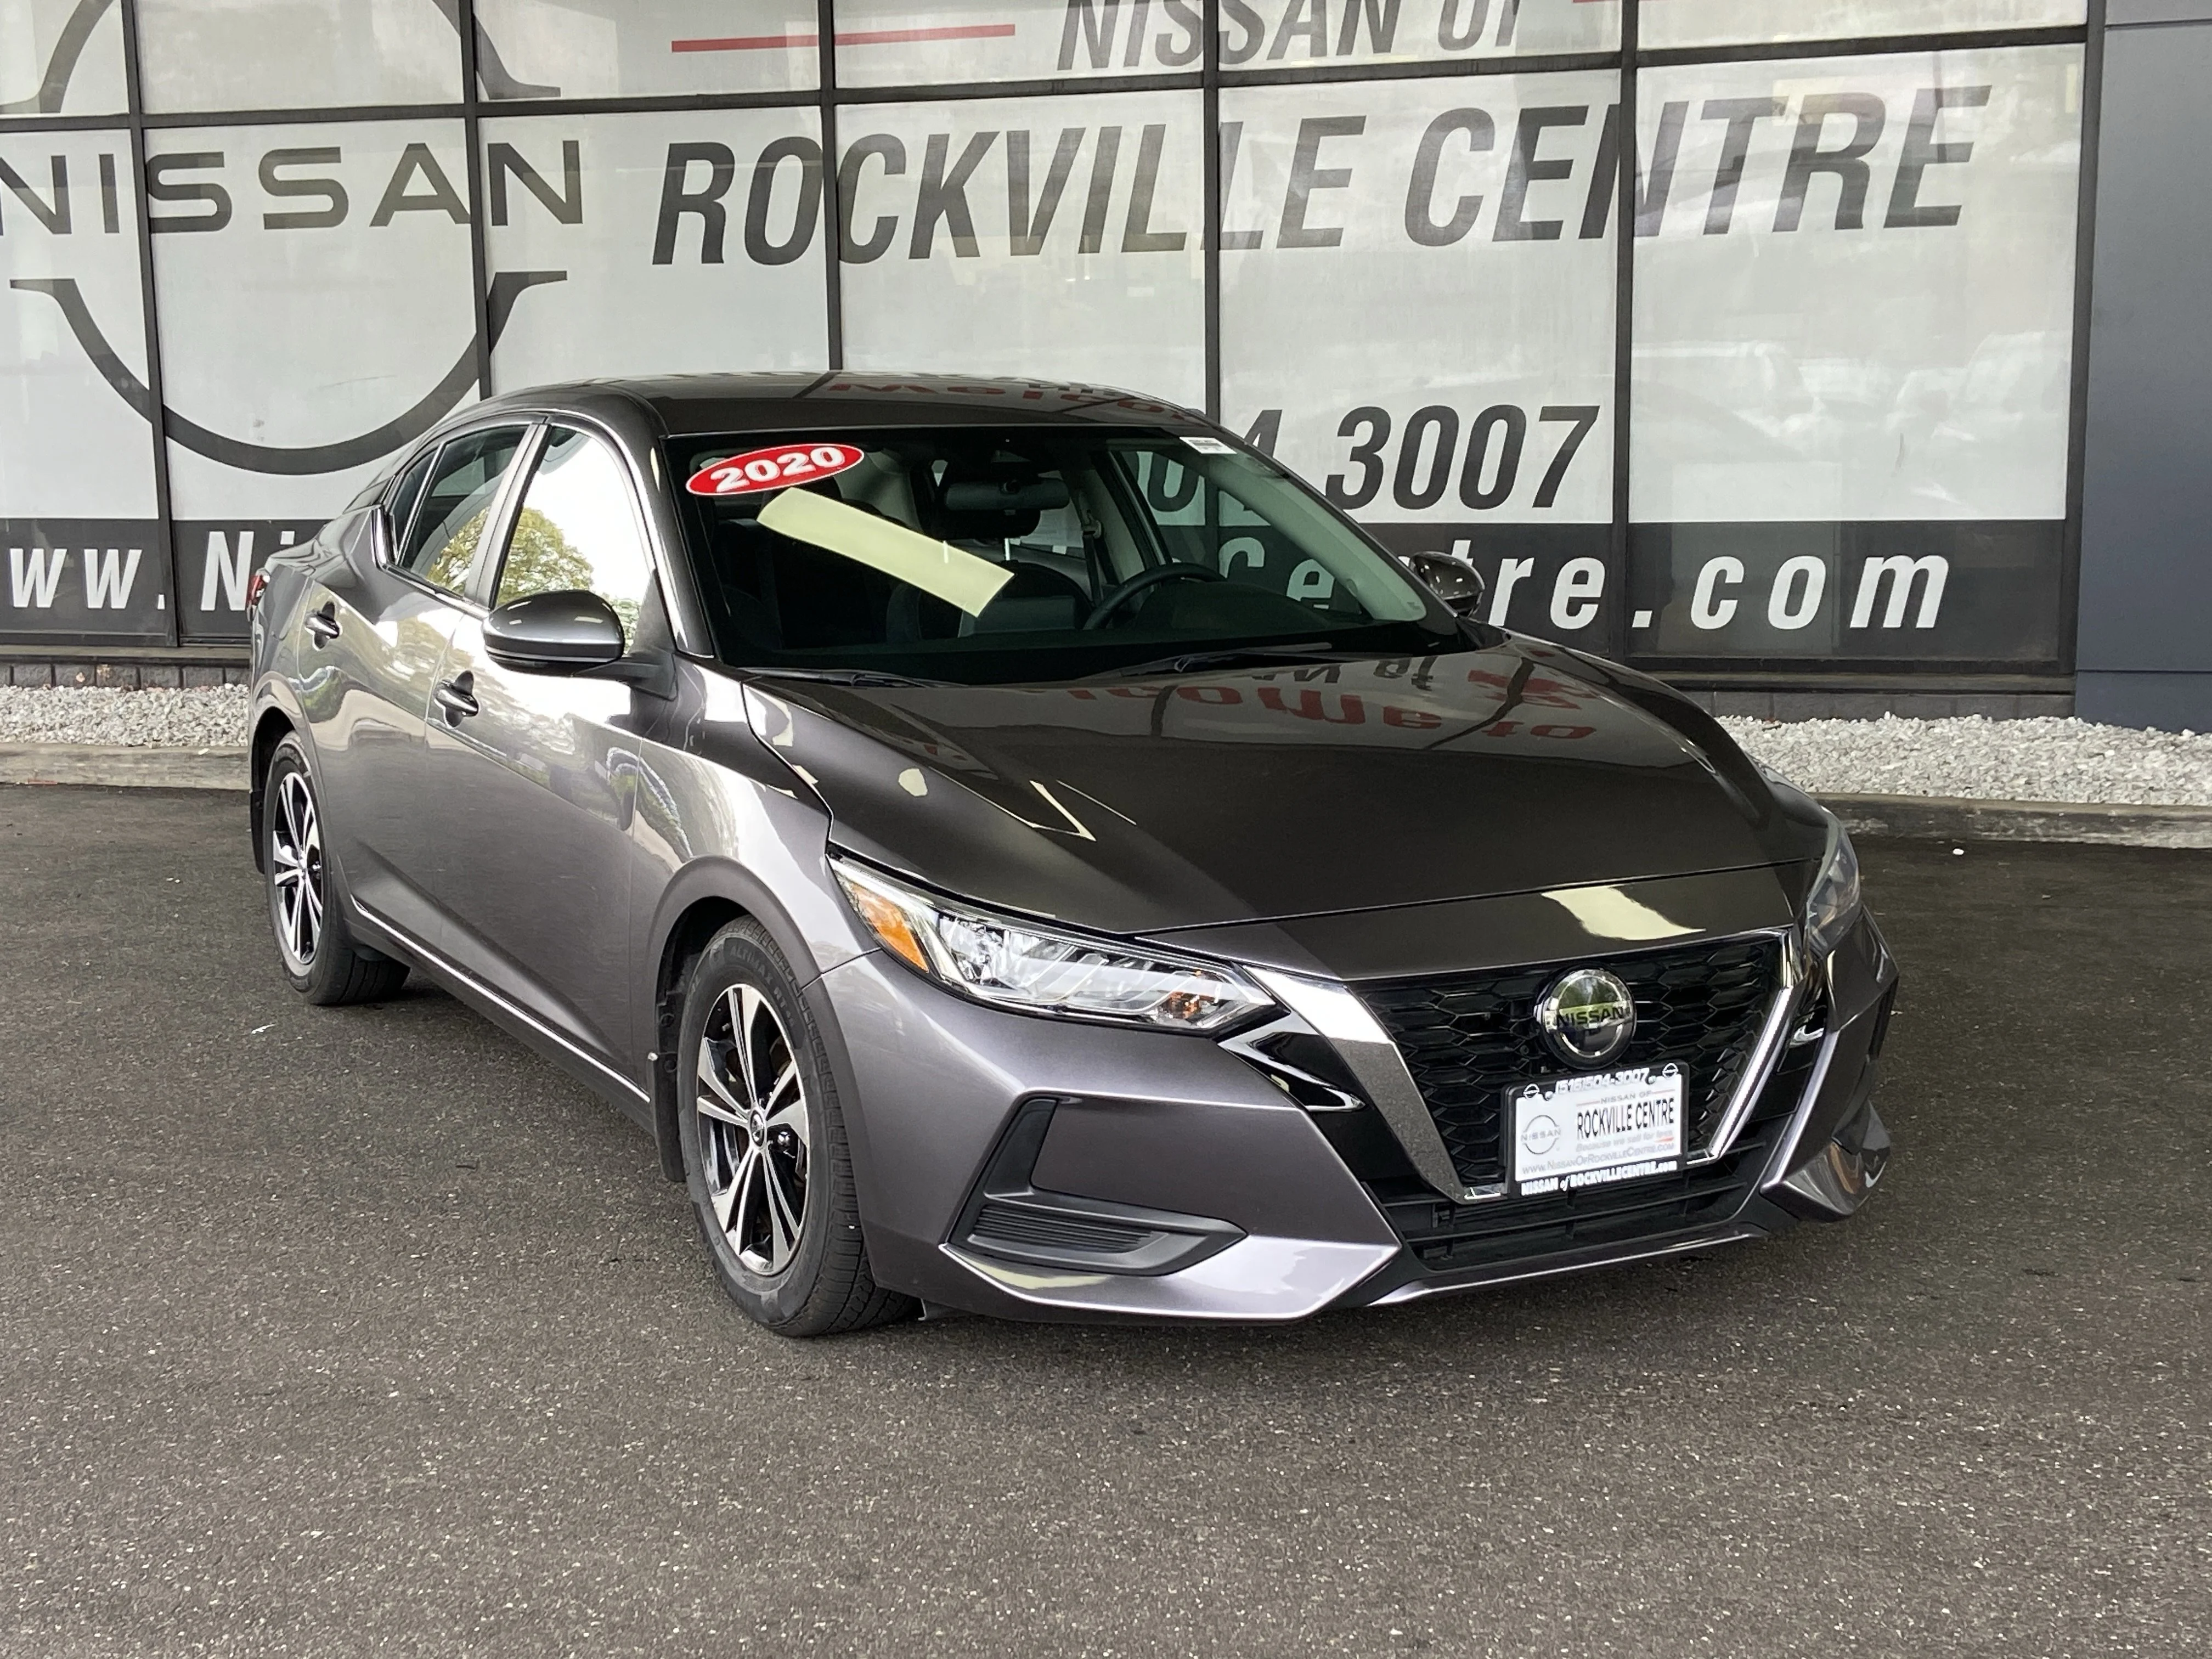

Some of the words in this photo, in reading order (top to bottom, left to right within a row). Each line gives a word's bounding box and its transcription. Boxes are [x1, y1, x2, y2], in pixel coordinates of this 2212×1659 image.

[0, 140, 583, 236] NISSAN
[652, 115, 1366, 266] ROCKVILLE
[1404, 85, 1991, 247] CENTRE
[710, 447, 845, 493] 2020
[1325, 405, 1599, 510] 3007
[1557, 1006, 1625, 1028] NISSAN
[1577, 1104, 1632, 1140] ROCKVILLE
[1635, 1097, 1674, 1130] CENTRE
[1600, 1093, 1636, 1104] NISSAN
[1520, 1128, 1561, 1142] NISSAN
[1521, 1177, 1559, 1196] NISSAN
